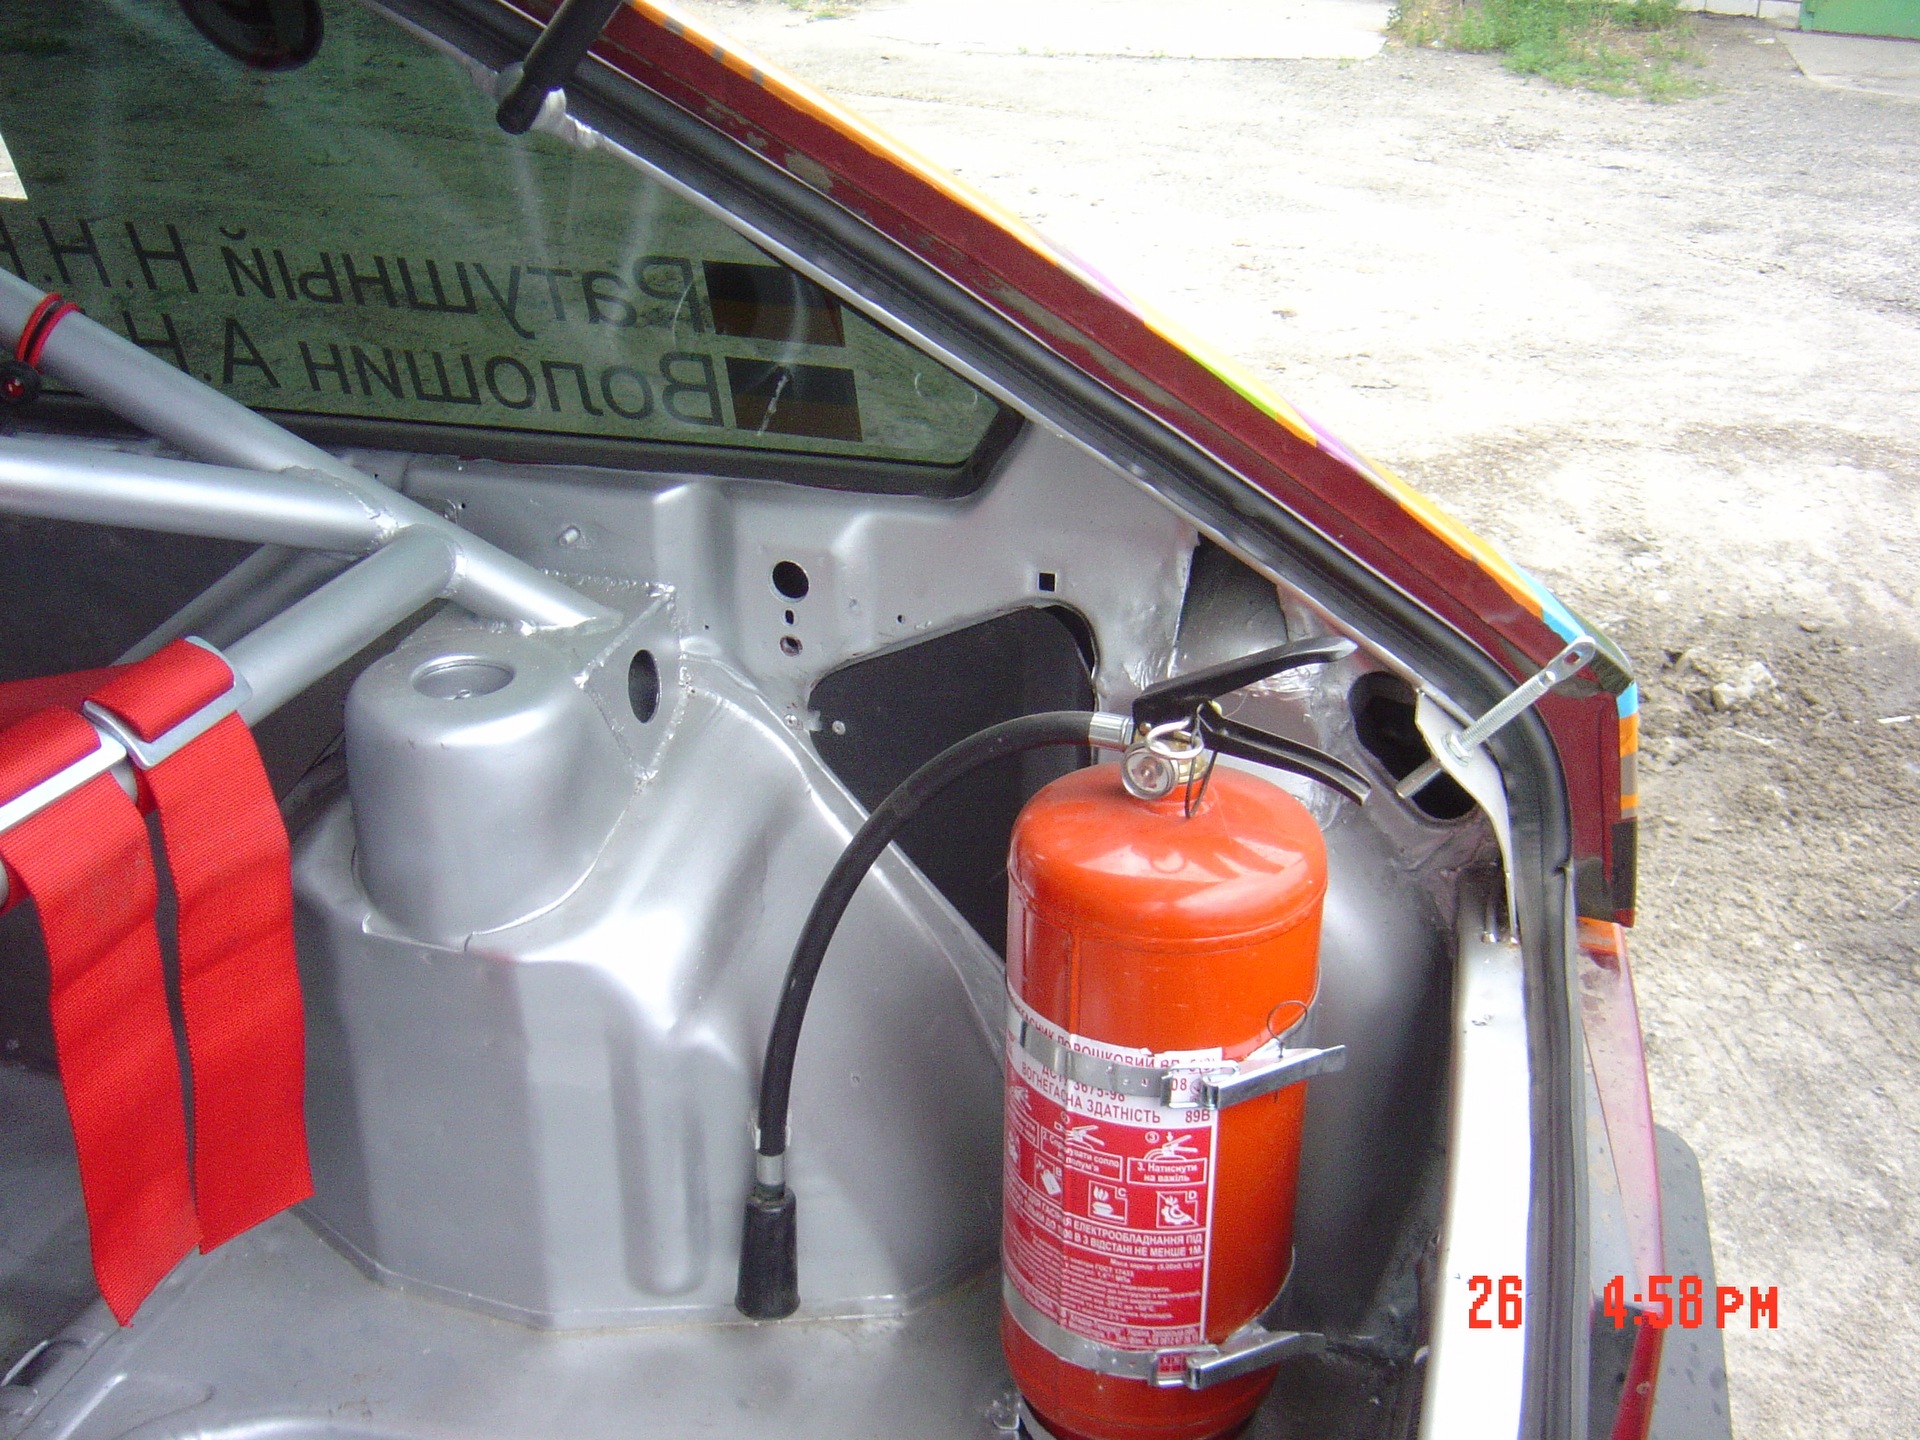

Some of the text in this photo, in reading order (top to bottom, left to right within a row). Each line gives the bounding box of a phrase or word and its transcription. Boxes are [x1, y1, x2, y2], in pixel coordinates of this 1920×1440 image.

[1086, 1098, 1161, 1124] ЗДАТНІСТЬ
[1148, 1162, 1198, 1174] Натиснути
[1158, 1174, 1191, 1183] важіль
[1090, 1236, 1133, 1254] ВІДСТАНІ
[1134, 1246, 1148, 1257] НЕ
[1150, 1246, 1187, 1258] МЕНШЕ
